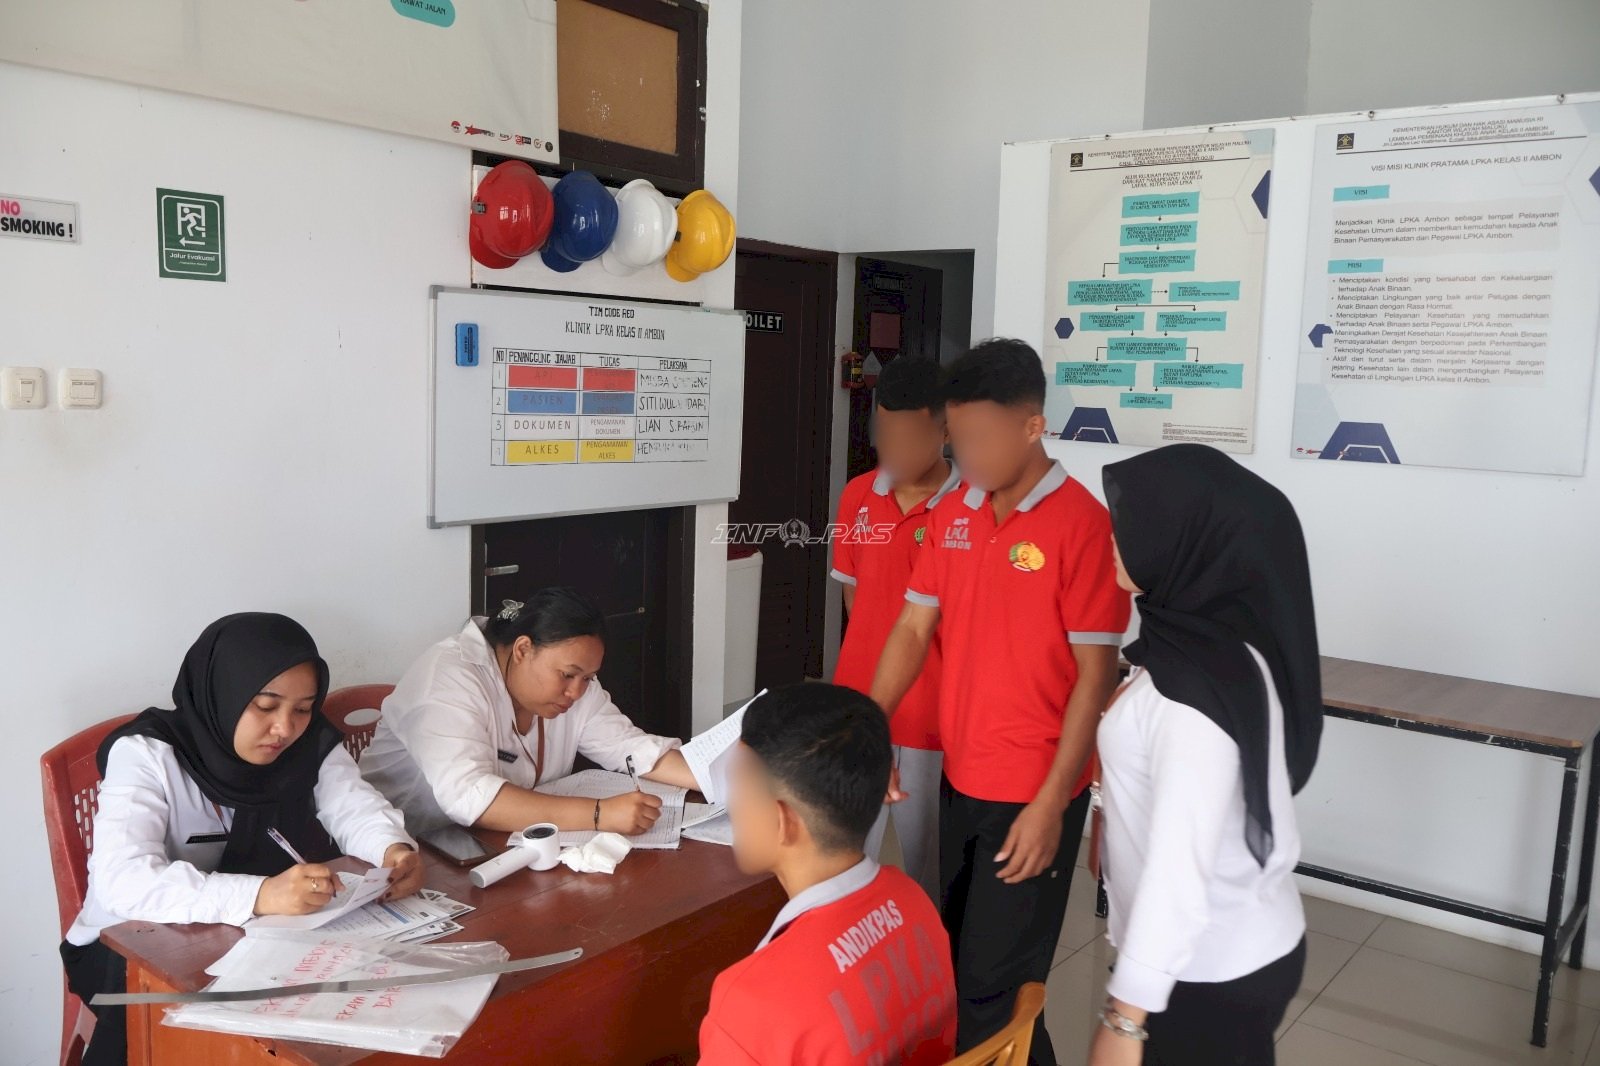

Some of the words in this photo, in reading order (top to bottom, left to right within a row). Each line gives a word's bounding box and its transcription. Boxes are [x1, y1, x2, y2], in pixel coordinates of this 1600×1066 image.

[400, 0, 422, 8] AWAT
[425, 4, 446, 15] JALAN
[1404, 162, 1429, 170] KLINIK
[1430, 159, 1469, 169] PRATAMA
[1470, 158, 1491, 166] LPKA
[1494, 156, 1521, 164] KELAS
[1529, 154, 1562, 162] AMBON
[1, 200, 20, 216] NO
[1, 217, 64, 237] SMOKING
[588, 306, 602, 317] TIM
[604, 307, 620, 318] CODE
[622, 309, 635, 318] RED
[746, 314, 781, 329] OILET
[566, 321, 590, 335] KLINIK
[596, 323, 613, 336] LPKA
[617, 325, 636, 338] KELAS
[644, 329, 665, 340] AMBON
[600, 356, 620, 367] TUGAS
[523, 394, 562, 405] PASIEN
[639, 396, 657, 410] SITI
[514, 420, 571, 430] DOKUMEN
[639, 419, 661, 433] LIAN
[526, 444, 559, 455] ALKES
[945, 527, 969, 540] LPKA
[828, 899, 903, 973] ANDIKPAS
[829, 921, 944, 1057] LPKA
